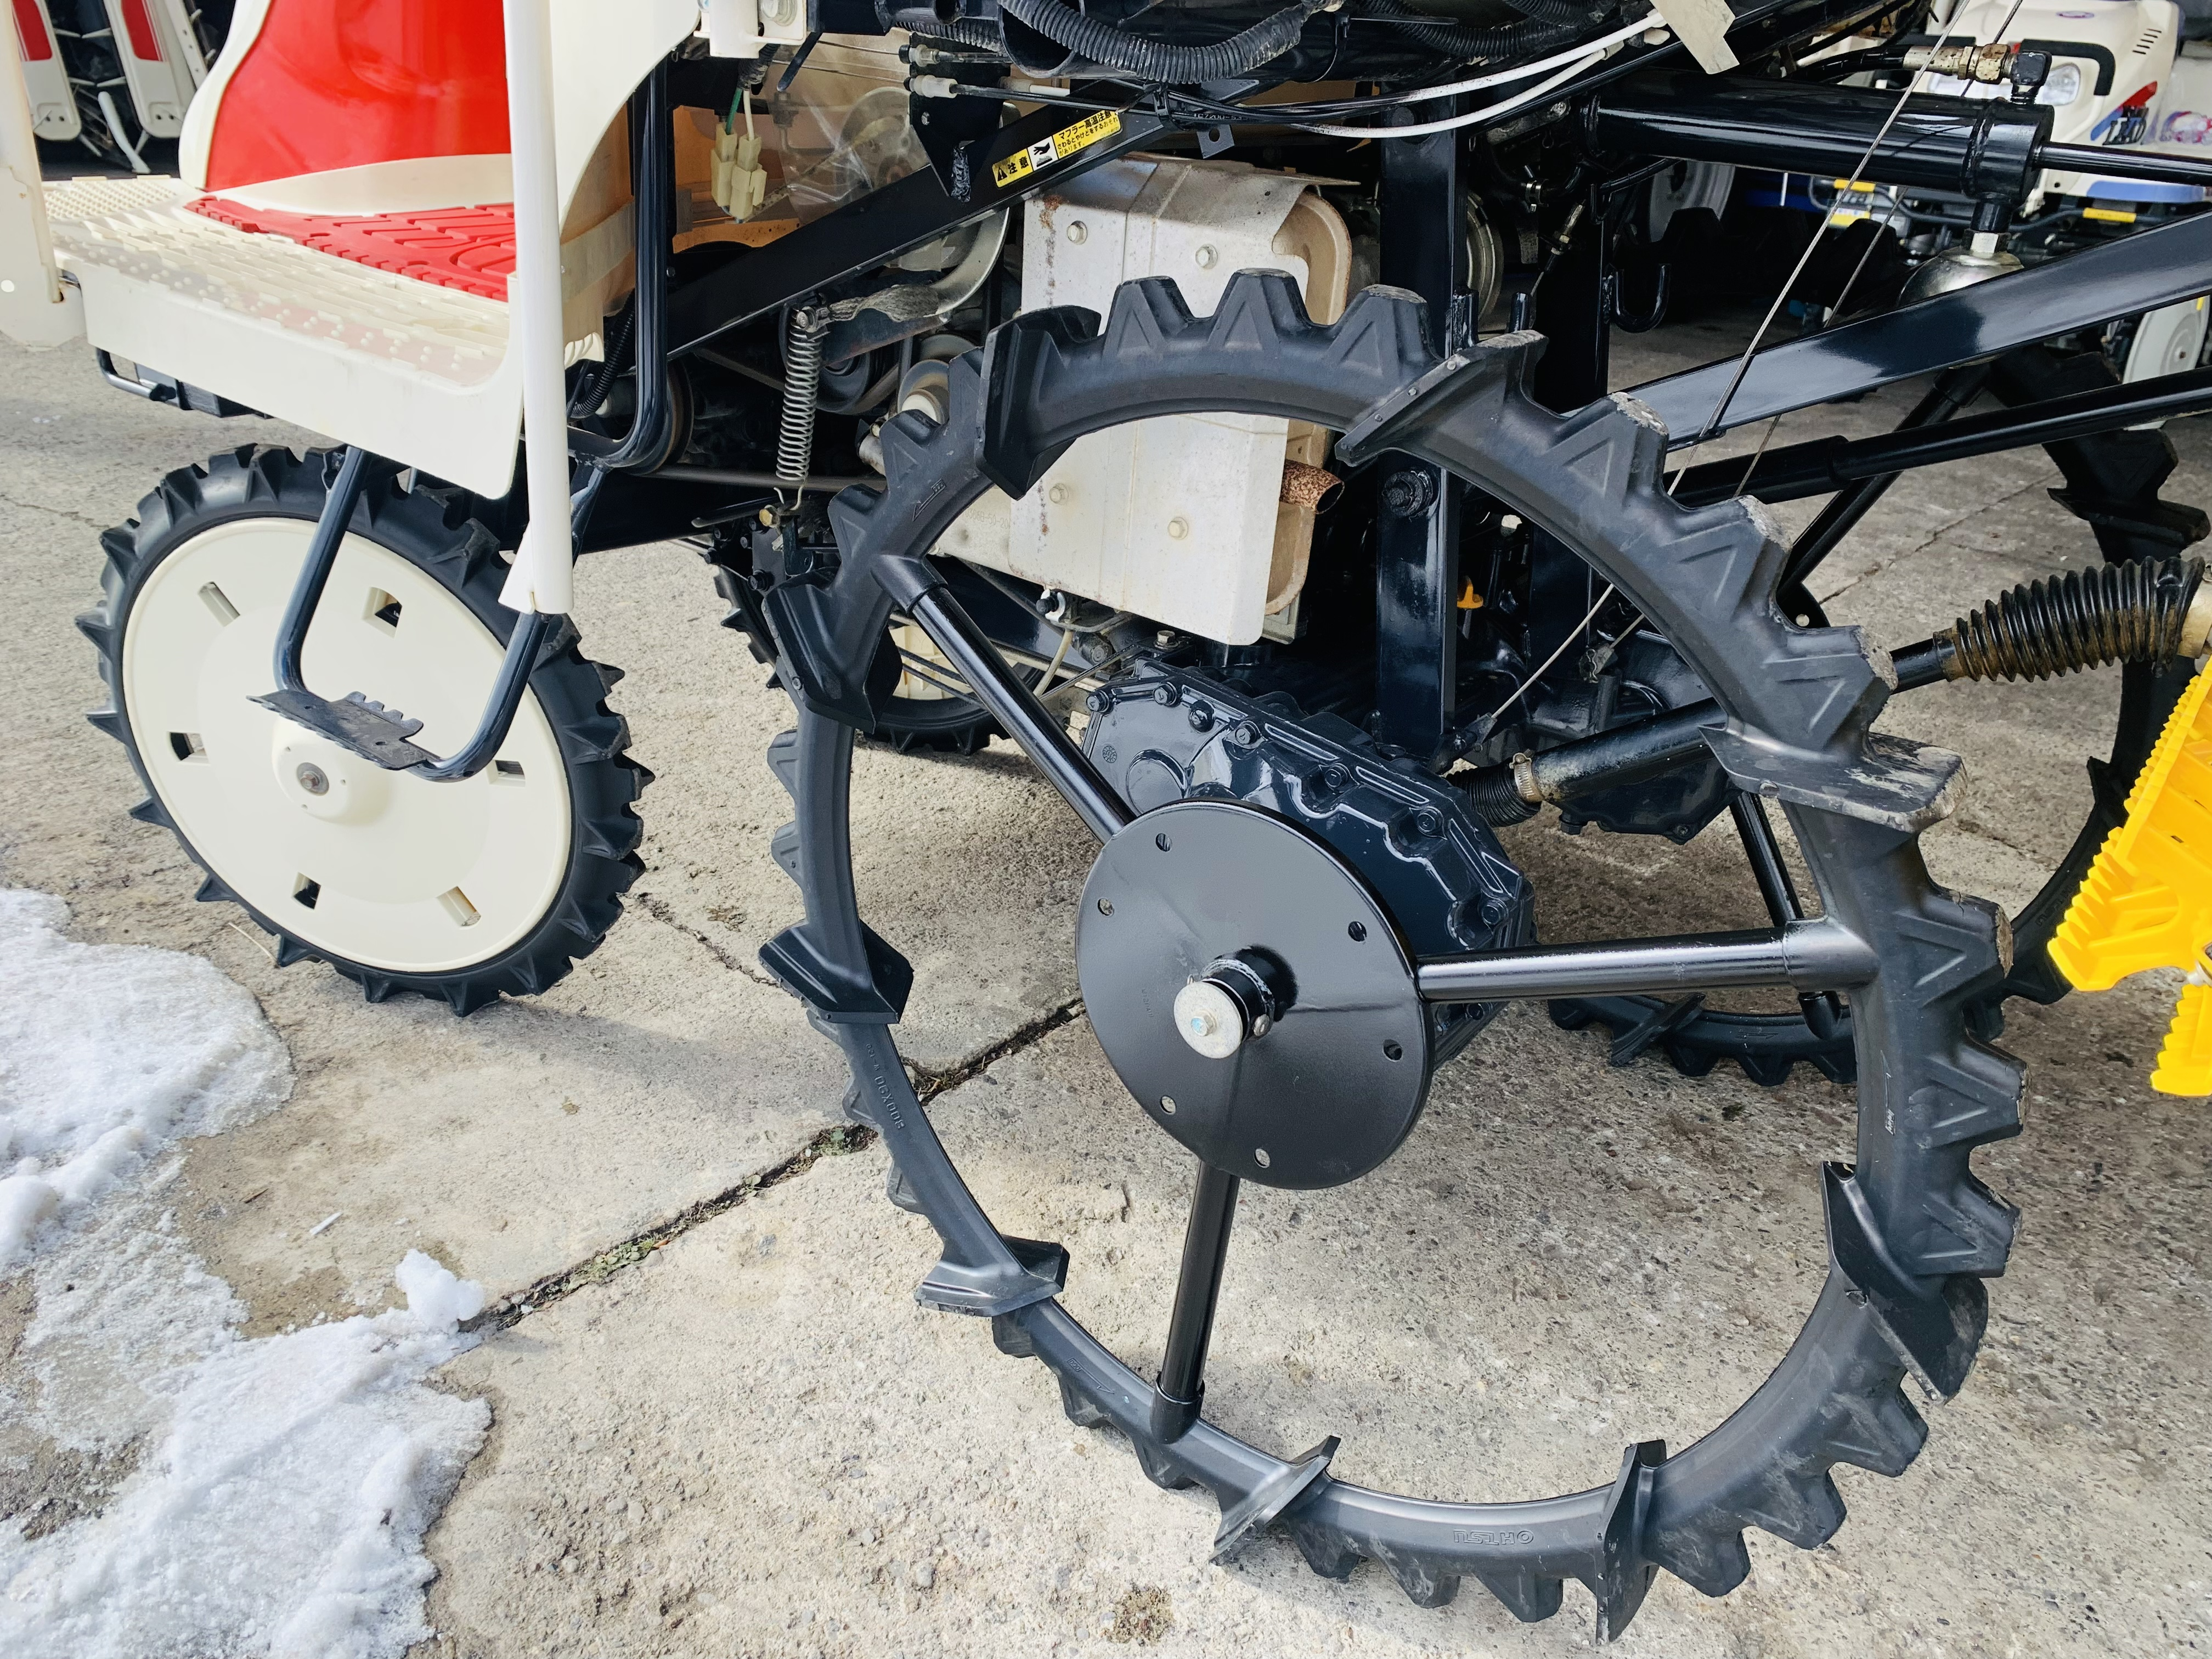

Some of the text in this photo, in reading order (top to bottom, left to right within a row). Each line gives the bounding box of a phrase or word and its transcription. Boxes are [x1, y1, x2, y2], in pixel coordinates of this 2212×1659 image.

[1057, 117, 1118, 150] さわるとやけどをするおそれ
[1059, 142, 1085, 156] があります。
[1007, 156, 1029, 174] 注意
[1454, 1529, 1534, 1545] OHTSU
